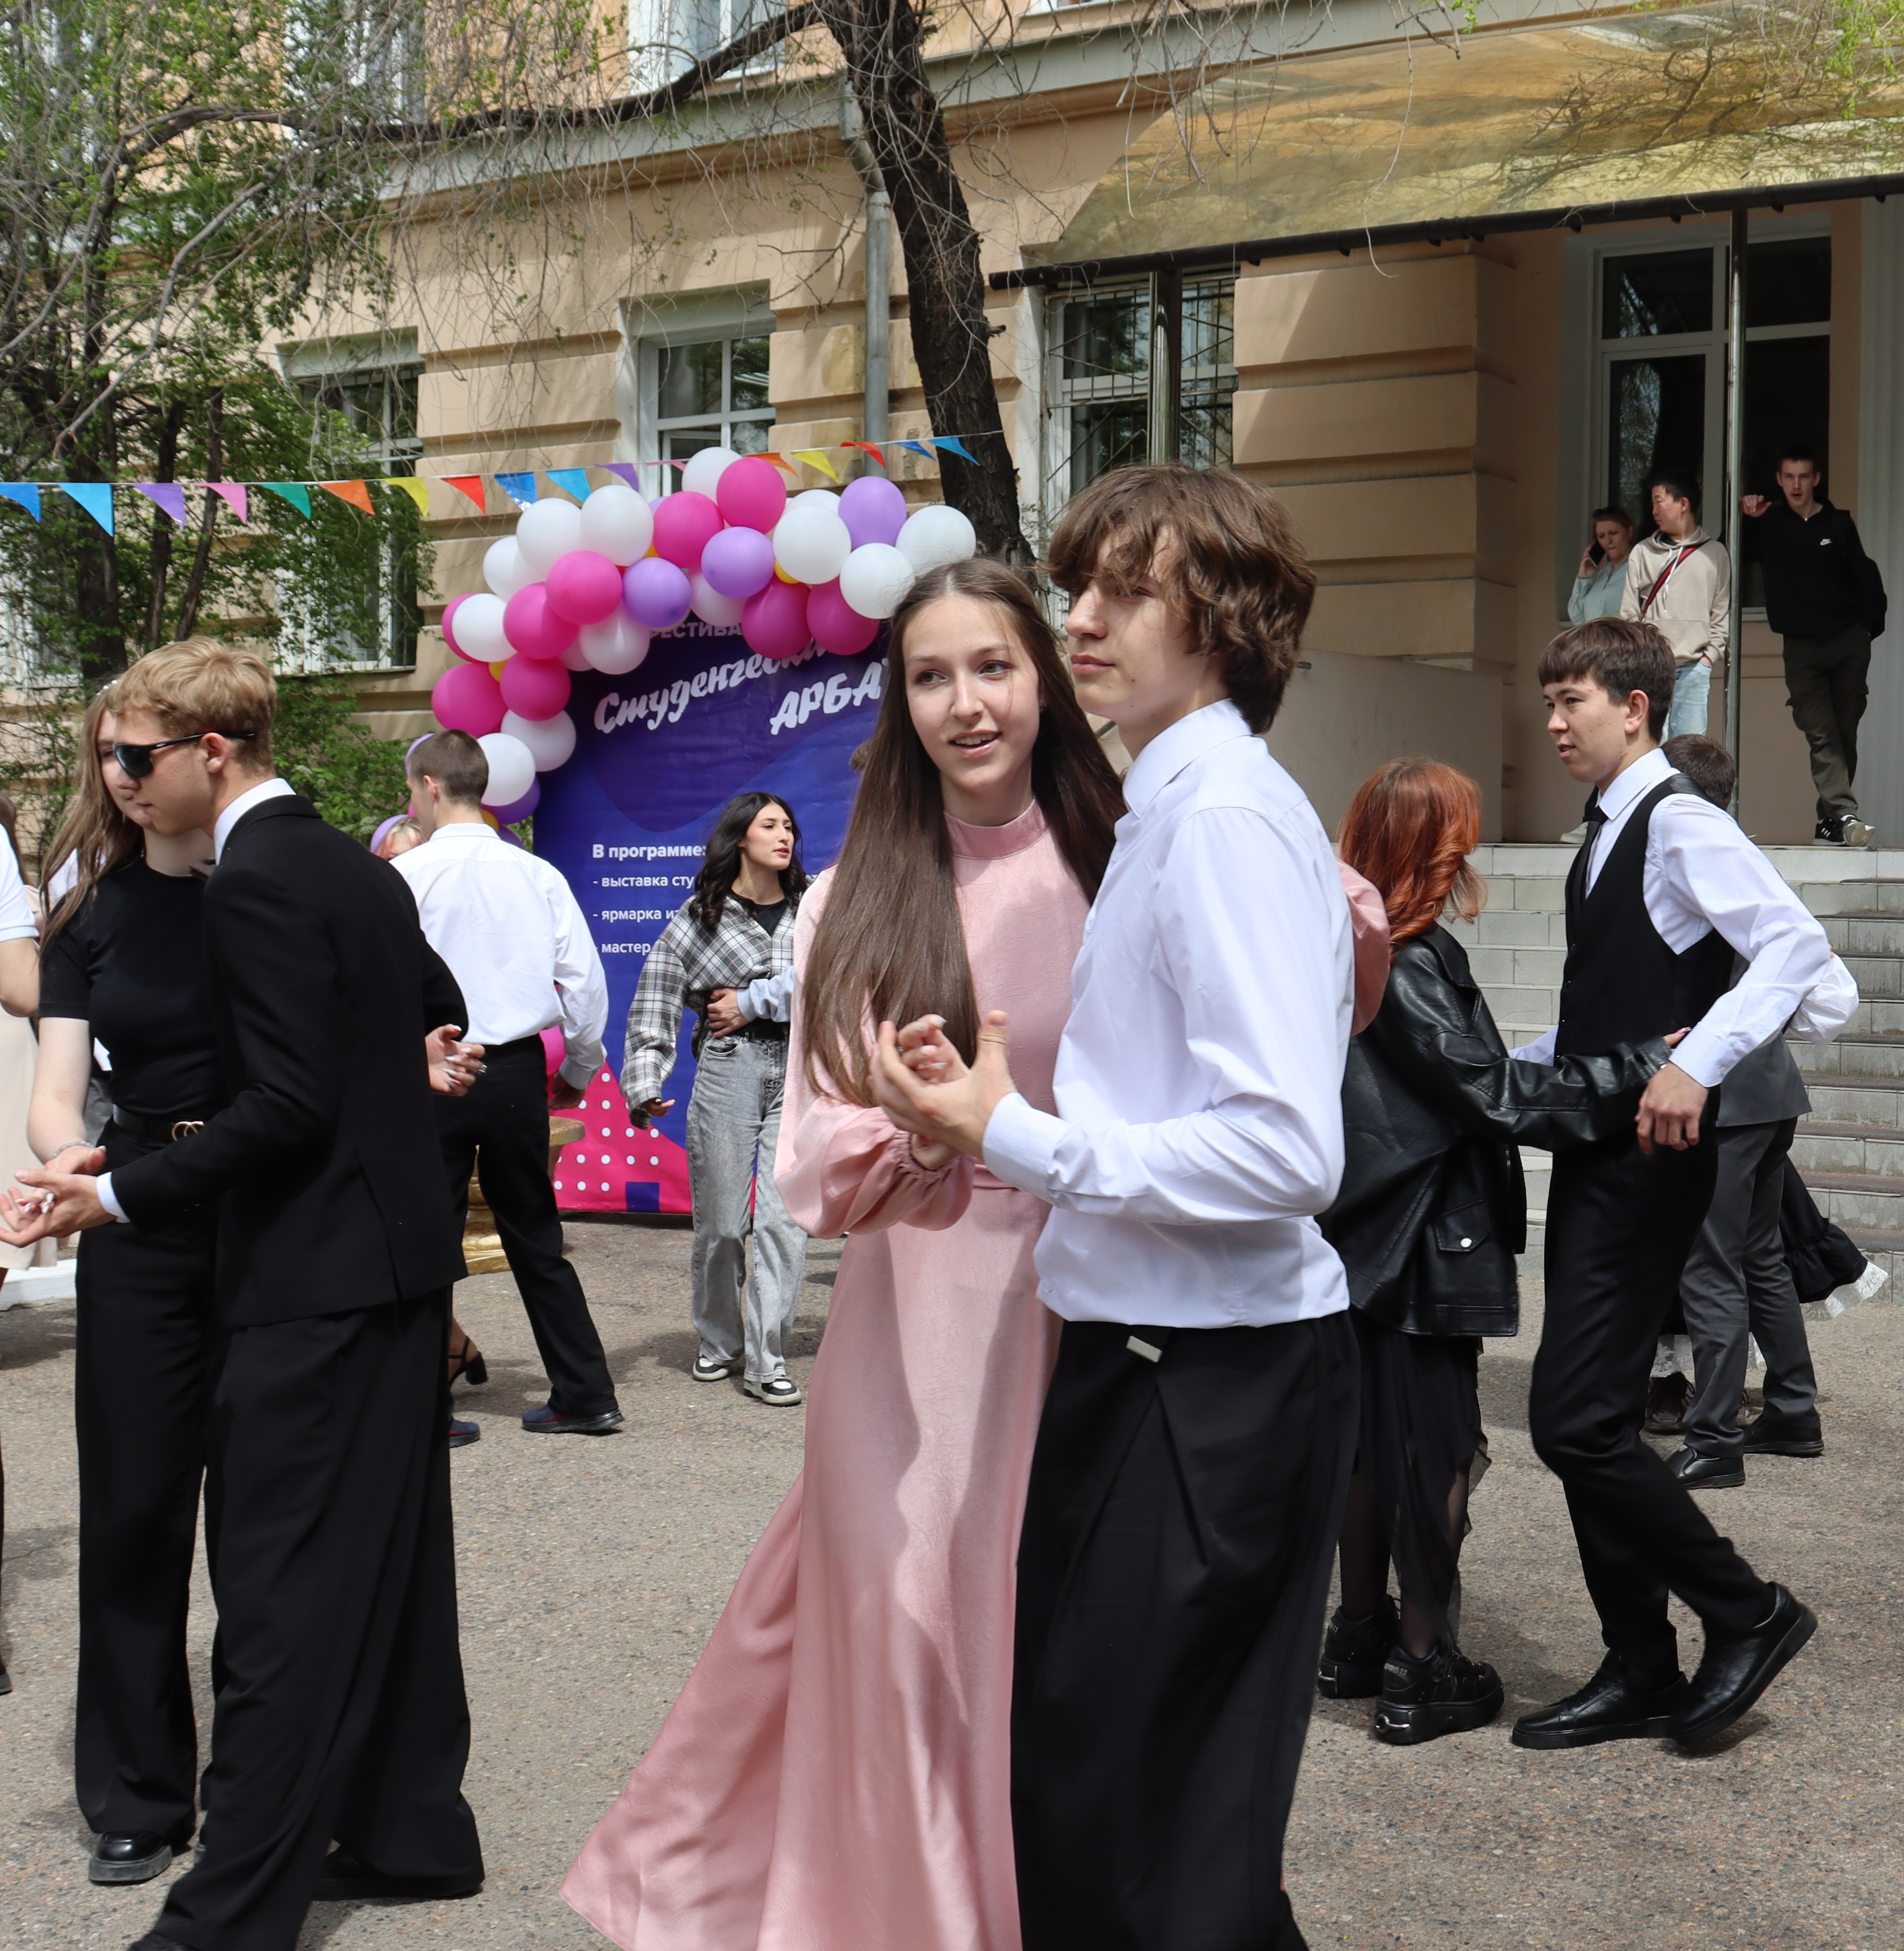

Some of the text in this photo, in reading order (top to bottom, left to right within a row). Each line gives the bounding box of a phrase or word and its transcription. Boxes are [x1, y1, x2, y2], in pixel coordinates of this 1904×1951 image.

[769, 658, 889, 735] АРБА
[592, 844, 707, 862] В программе:
[601, 876, 668, 887] выставка
[672, 876, 695, 889] сту
[601, 909, 661, 923] ярмарка
